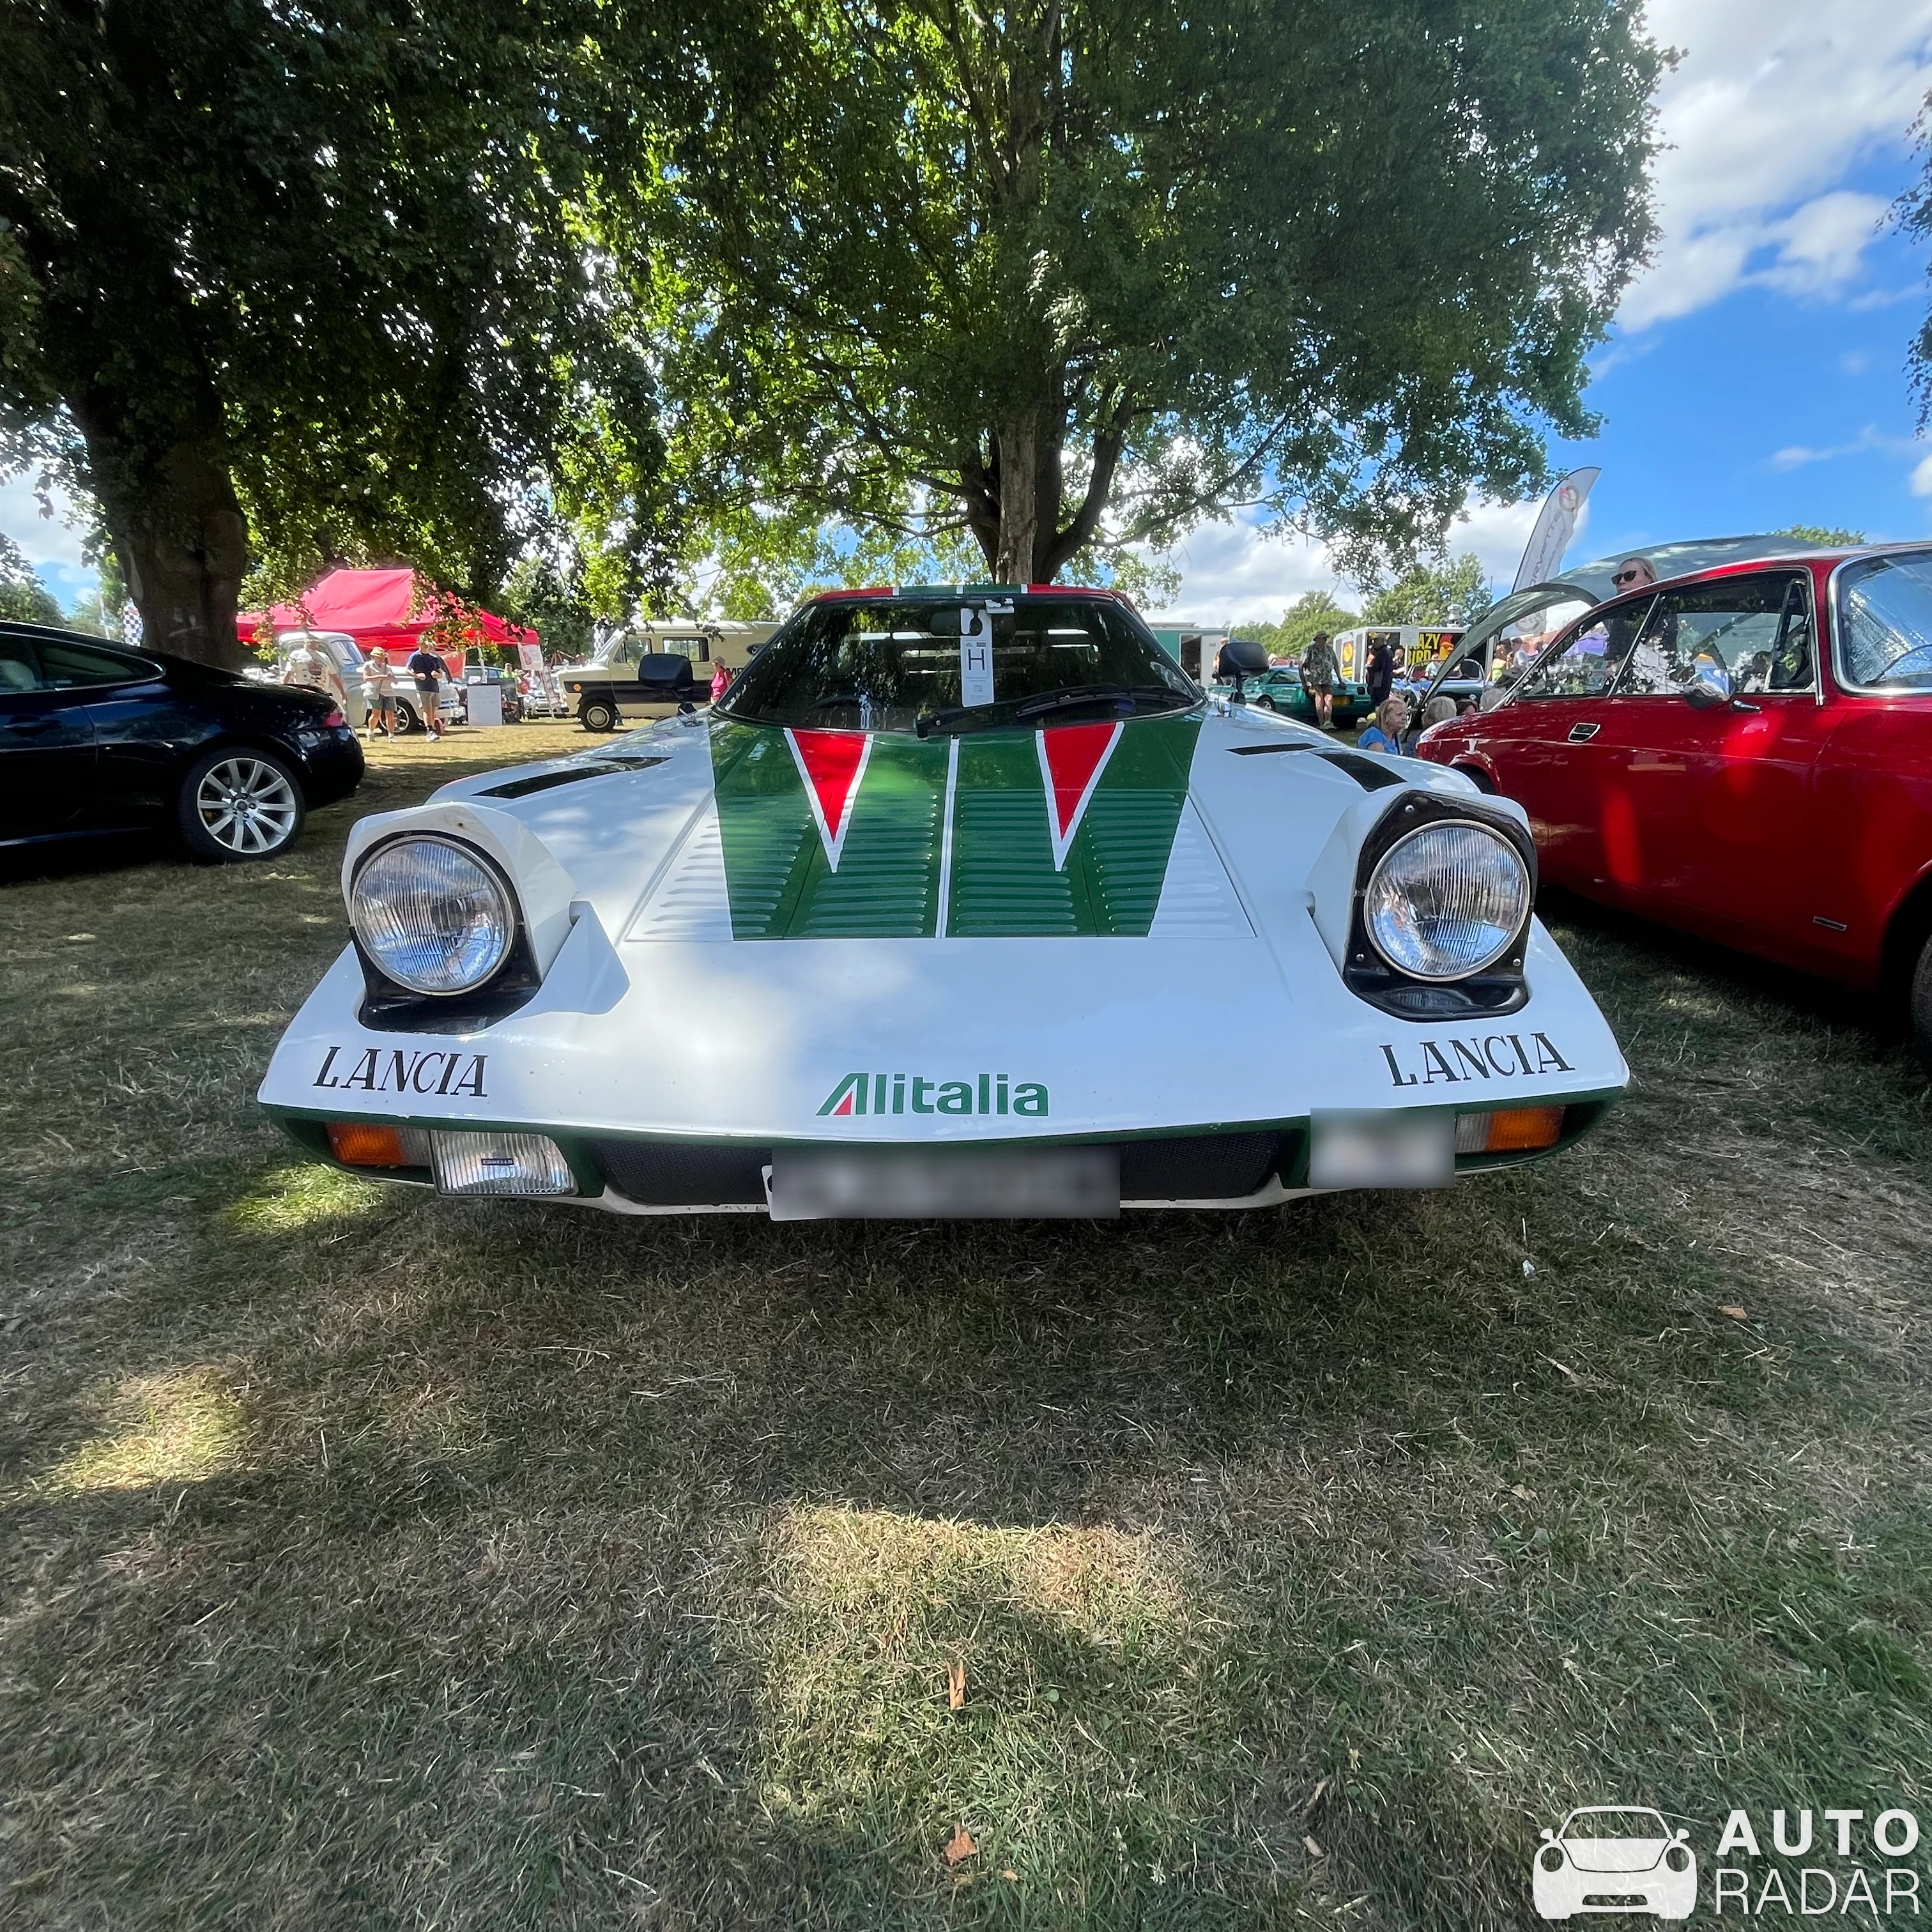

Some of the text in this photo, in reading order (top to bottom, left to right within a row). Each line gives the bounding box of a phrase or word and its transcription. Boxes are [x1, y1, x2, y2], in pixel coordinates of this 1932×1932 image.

[1530, 509, 1562, 586] ORVETTE
[968, 648, 985, 670] H
[1409, 633, 1441, 650] AZY
[313, 1046, 488, 1097] LANCIA
[1379, 1032, 1575, 1086] LANCIA
[816, 1073, 1048, 1117] Alitalia
